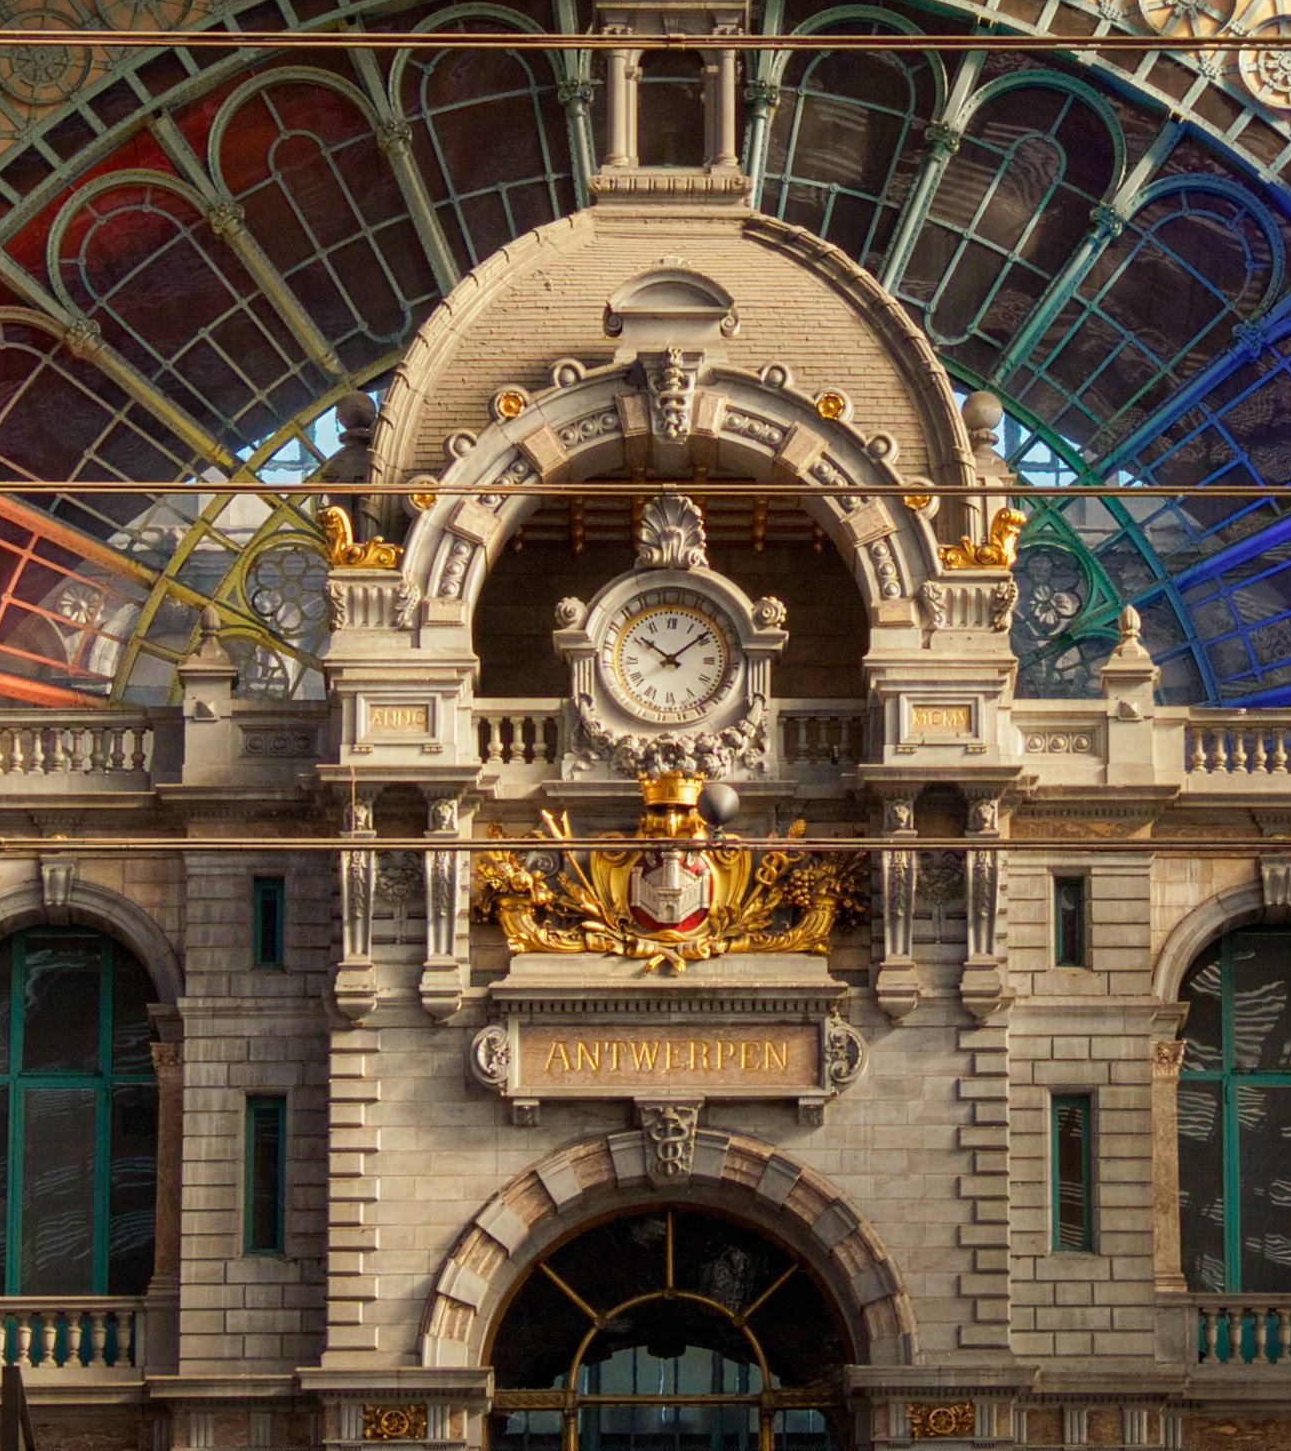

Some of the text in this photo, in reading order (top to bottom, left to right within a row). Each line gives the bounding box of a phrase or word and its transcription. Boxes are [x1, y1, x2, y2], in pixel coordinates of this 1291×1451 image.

[687, 623, 694, 634] I
[703, 657, 715, 665] III
[368, 708, 426, 726] ANNO
[544, 1040, 790, 1073] ANTWERPEN
